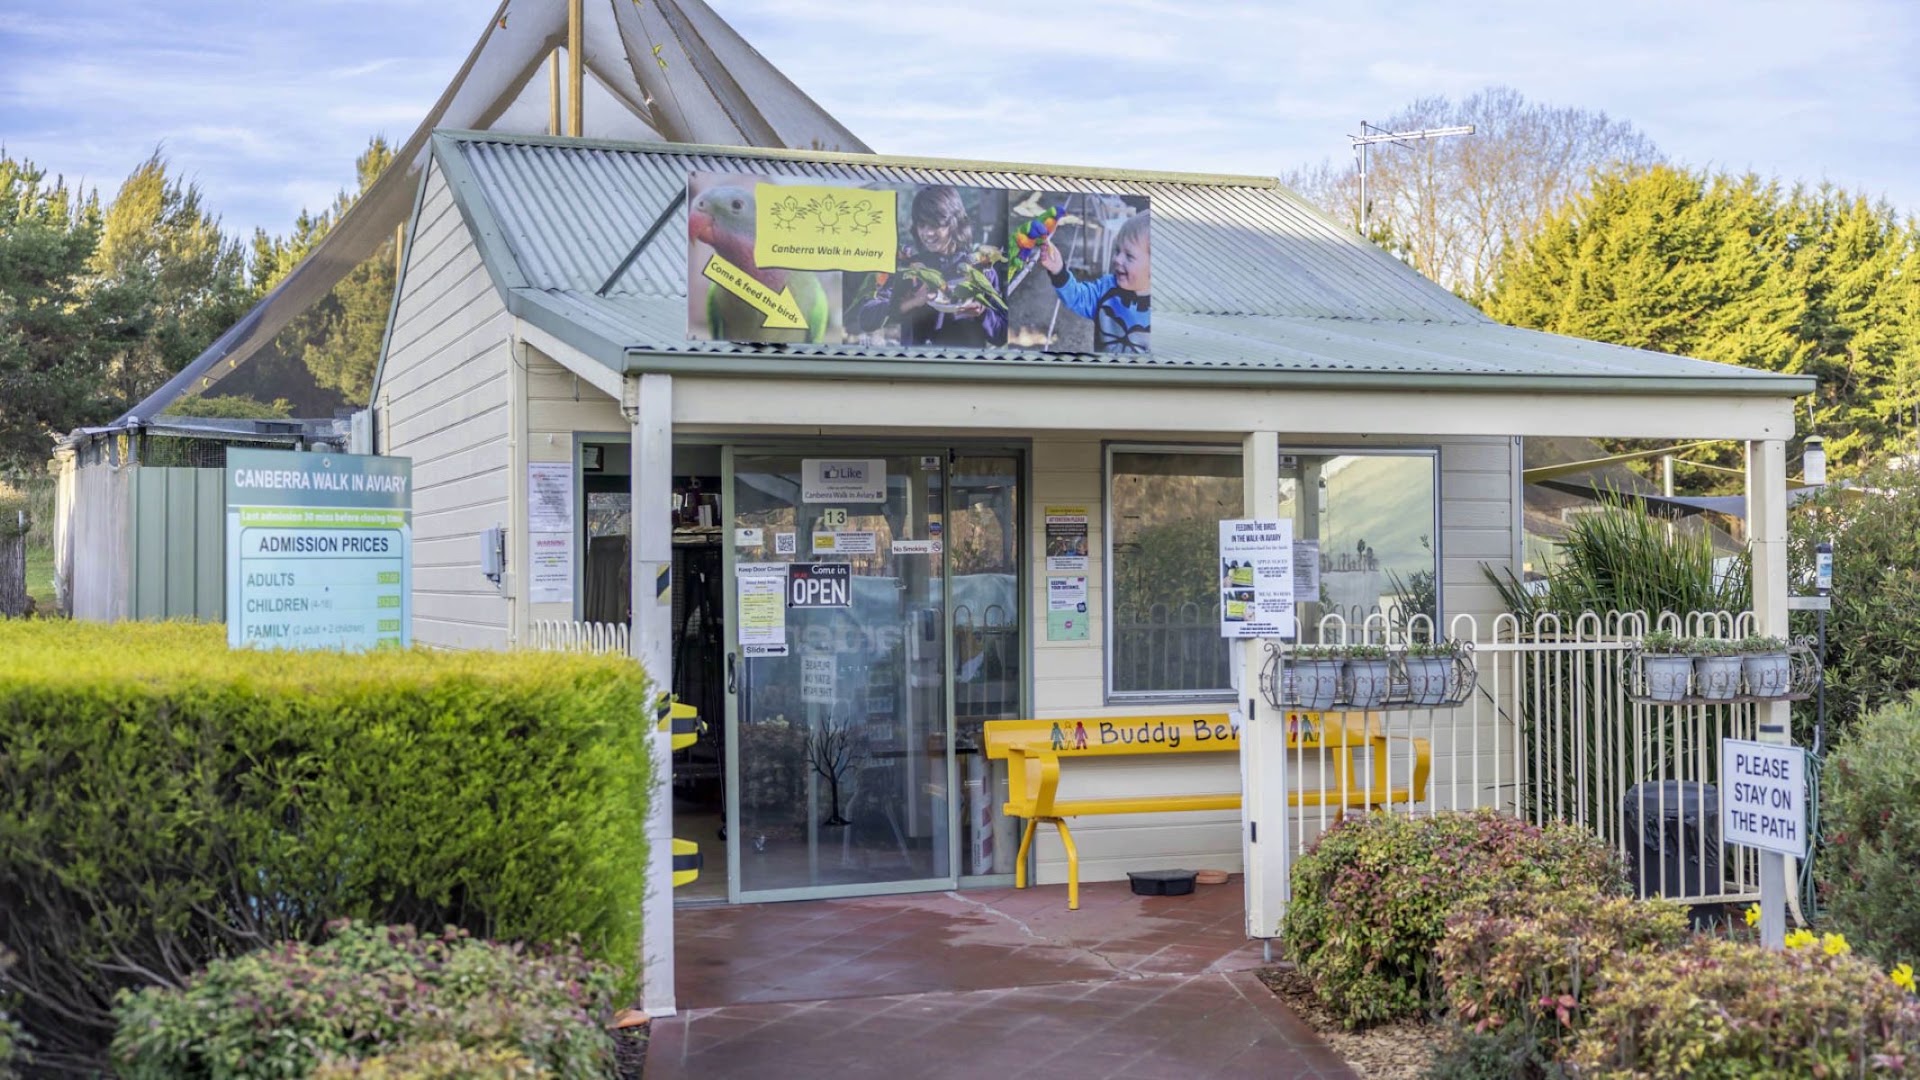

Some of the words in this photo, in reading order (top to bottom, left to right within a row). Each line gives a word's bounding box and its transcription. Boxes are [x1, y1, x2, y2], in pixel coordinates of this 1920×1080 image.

[771, 244, 814, 255] Canberra
[818, 245, 840, 256] Walk
[843, 246, 852, 256] in
[854, 247, 884, 260] Aviary
[711, 262, 735, 282] Come
[735, 278, 743, 287] &
[742, 281, 762, 300] feed
[762, 295, 777, 309] the
[777, 304, 799, 324] birds
[235, 469, 310, 489] CANBERRA
[312, 472, 349, 491] WALK
[352, 474, 364, 491] IN
[366, 475, 407, 493] AVIARY
[841, 468, 862, 479] Like
[805, 491, 832, 499] Canberra
[857, 491, 875, 500] Aviary
[242, 511, 260, 521] Last
[335, 512, 360, 523] before
[360, 513, 387, 525] closing
[1236, 523, 1254, 531] FEEDING
[259, 536, 338, 552] ADMISSION
[342, 537, 389, 552] PRICES
[1266, 533, 1281, 541] AVIARY
[811, 565, 835, 575] Come
[837, 564, 847, 575] in
[247, 573, 295, 587] ADULTS
[793, 579, 846, 604] OPEN
[247, 598, 309, 613] CHILDREN
[247, 624, 290, 638] FAMILY
[1099, 722, 1180, 748] Buddy
[1736, 754, 1789, 780] PLEASE
[1735, 782, 1768, 805] STAY
[1771, 788, 1791, 810] ON
[1731, 810, 1757, 833] THE
[1761, 815, 1796, 841] PATH
